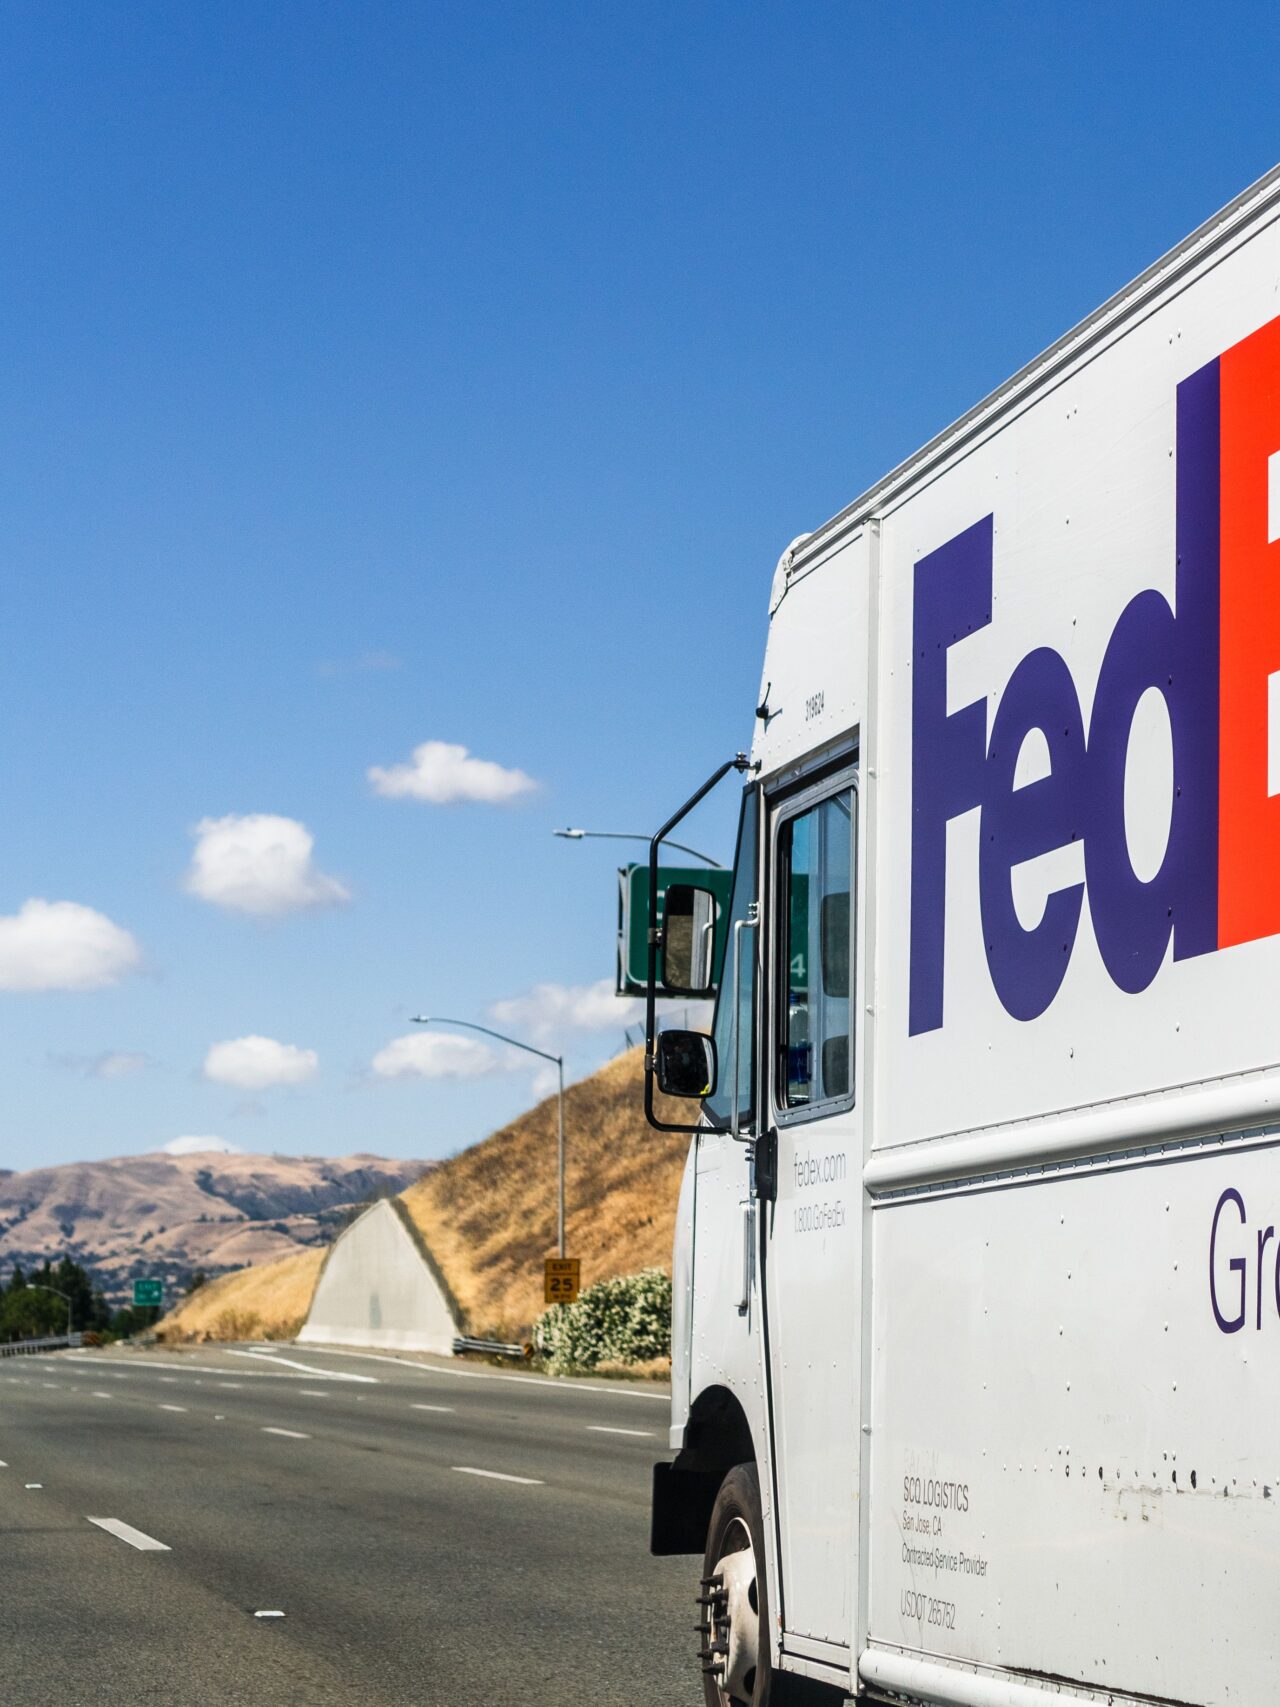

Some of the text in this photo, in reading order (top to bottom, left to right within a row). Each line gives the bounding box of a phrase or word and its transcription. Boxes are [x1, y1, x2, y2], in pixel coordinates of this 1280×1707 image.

[793, 1150, 847, 1188] fedex.com
[550, 1277, 573, 1292] 25
[903, 1475, 969, 1512] SCQ LOGISTICS
[902, 1510, 942, 1537] San Jose, CA
[901, 1542, 988, 1577] Contracted Service Provider
[900, 1588, 927, 1621] USDOT
